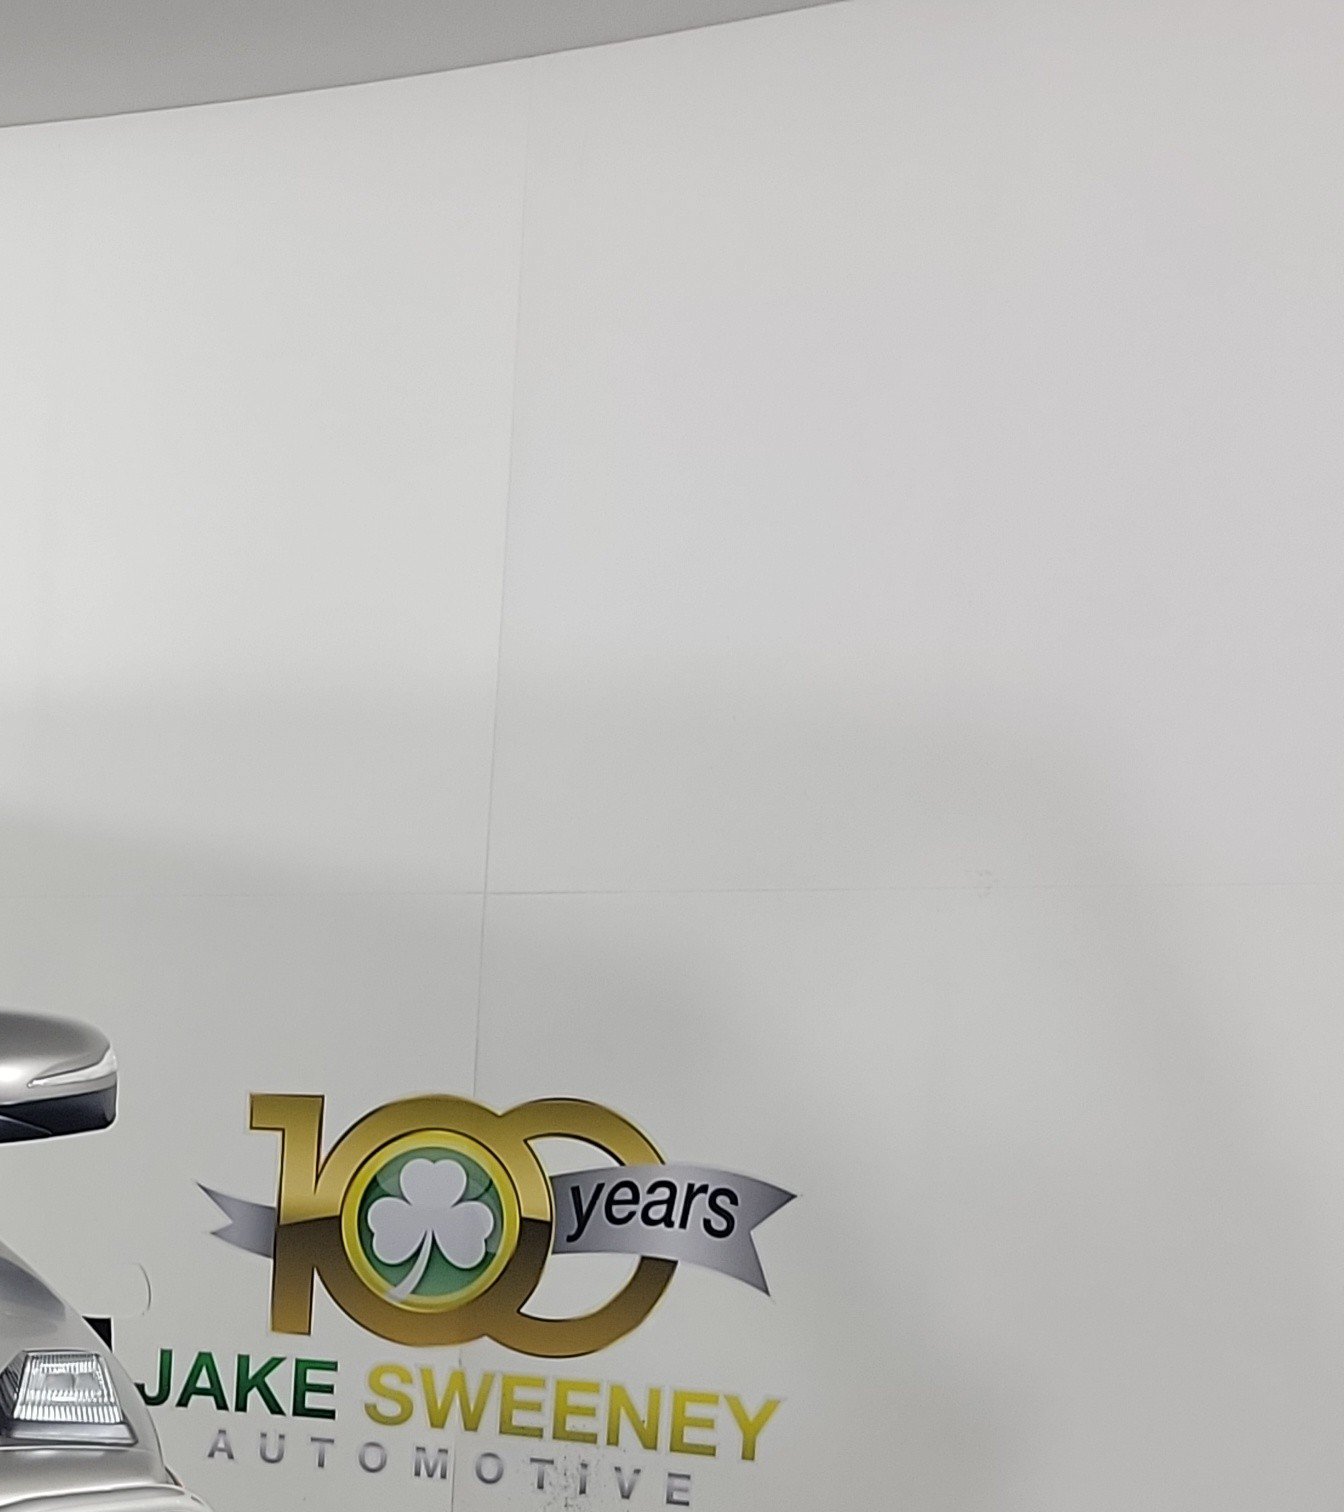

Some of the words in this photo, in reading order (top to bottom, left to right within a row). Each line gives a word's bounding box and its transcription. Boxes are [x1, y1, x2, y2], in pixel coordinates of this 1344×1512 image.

[248, 1091, 679, 1358] 100
[564, 1177, 740, 1244] years
[137, 1348, 339, 1421] JAKE
[363, 1361, 782, 1463] SWEENEY
[206, 1428, 692, 1507] AUTOMOTIVE
